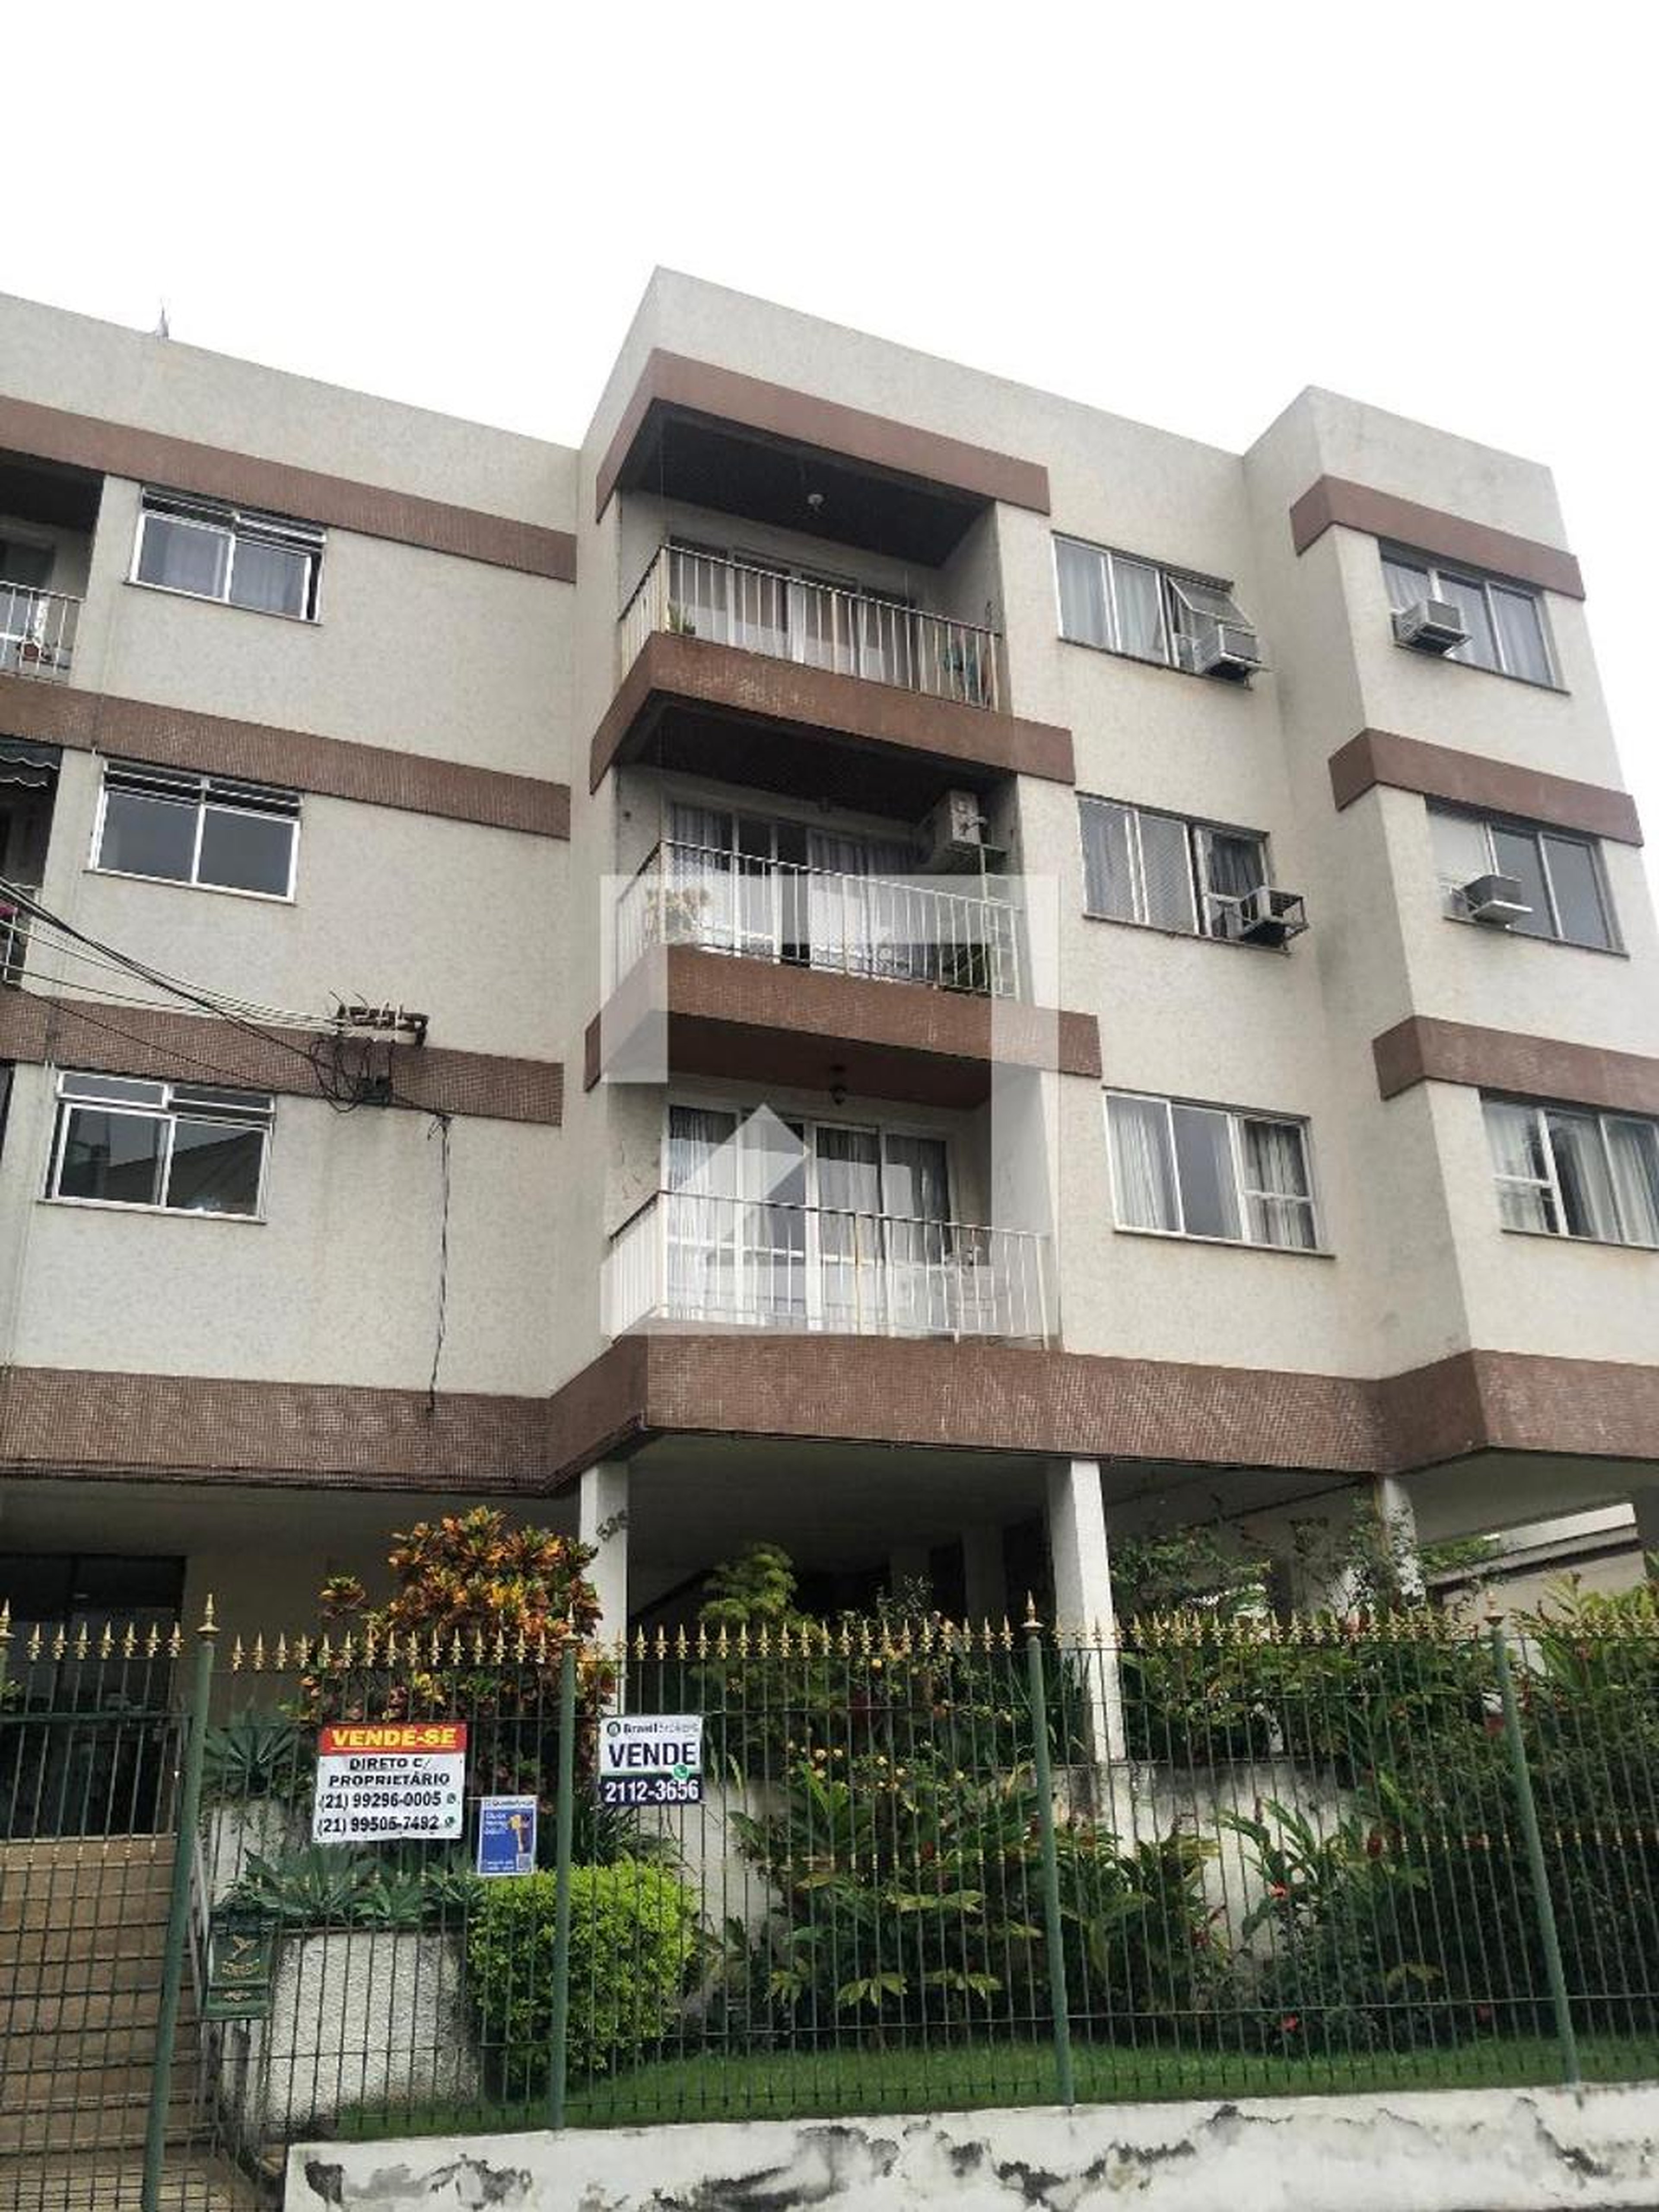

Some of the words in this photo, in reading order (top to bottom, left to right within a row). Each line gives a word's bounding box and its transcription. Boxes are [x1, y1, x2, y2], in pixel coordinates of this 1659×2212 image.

[332, 1728, 456, 1746] VENDE-SE
[350, 1758, 407, 1770] DIRETO
[608, 1743, 696, 1767] VENDE
[329, 1771, 450, 1786] PROPRIETÁRIO
[605, 1780, 699, 1802] 2112-3656
[320, 1793, 348, 1812] (21)
[353, 1791, 441, 1808] 99296-0005
[318, 1818, 346, 1836] (21)
